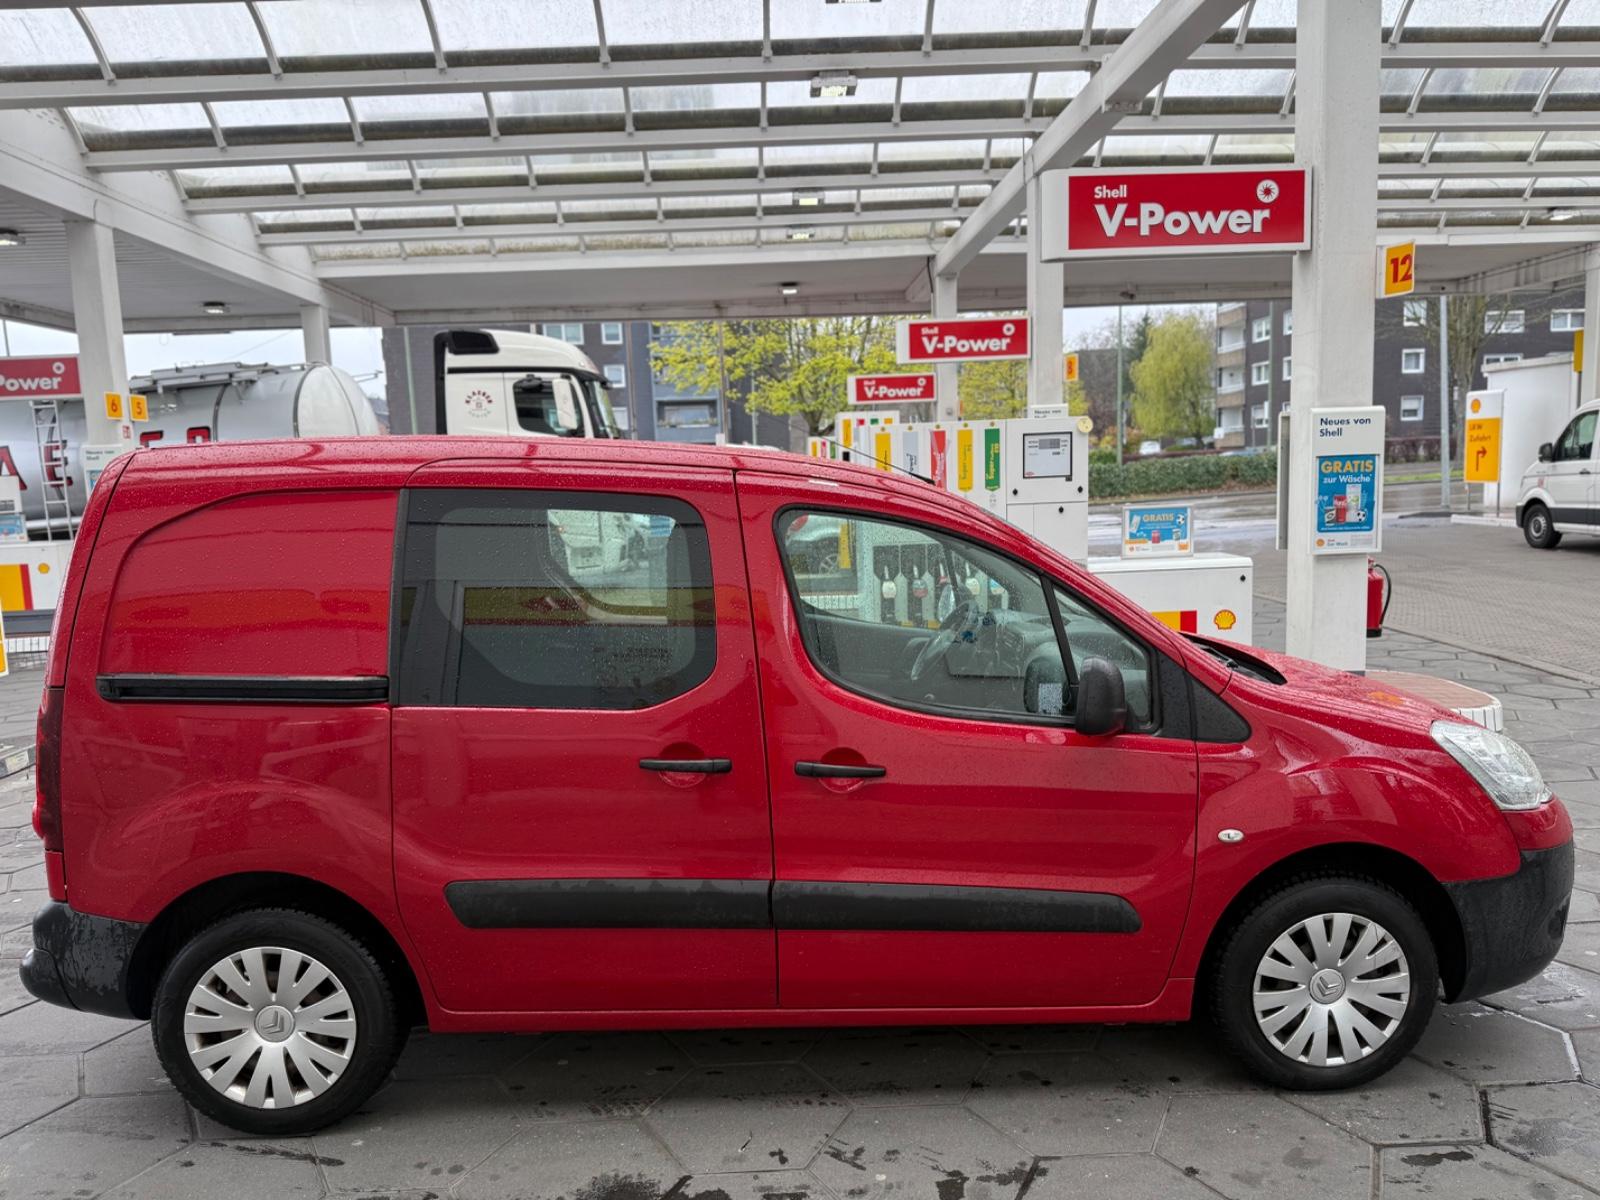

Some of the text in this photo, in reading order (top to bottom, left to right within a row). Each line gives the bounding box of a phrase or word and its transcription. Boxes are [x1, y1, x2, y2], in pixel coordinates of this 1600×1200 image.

[1094, 185, 1127, 199] Shell
[1094, 202, 1270, 237] V-Power
[1390, 254, 1412, 283] 12
[921, 327, 939, 335] Shell
[922, 336, 1011, 354] V-Power
[864, 385, 924, 398] V-Power
[111, 398, 118, 412] 6
[1320, 418, 1350, 426] Neues
[1319, 428, 1342, 437] Shell
[1321, 460, 1374, 473] GRATIS
[1143, 512, 1175, 522] GRATIS
